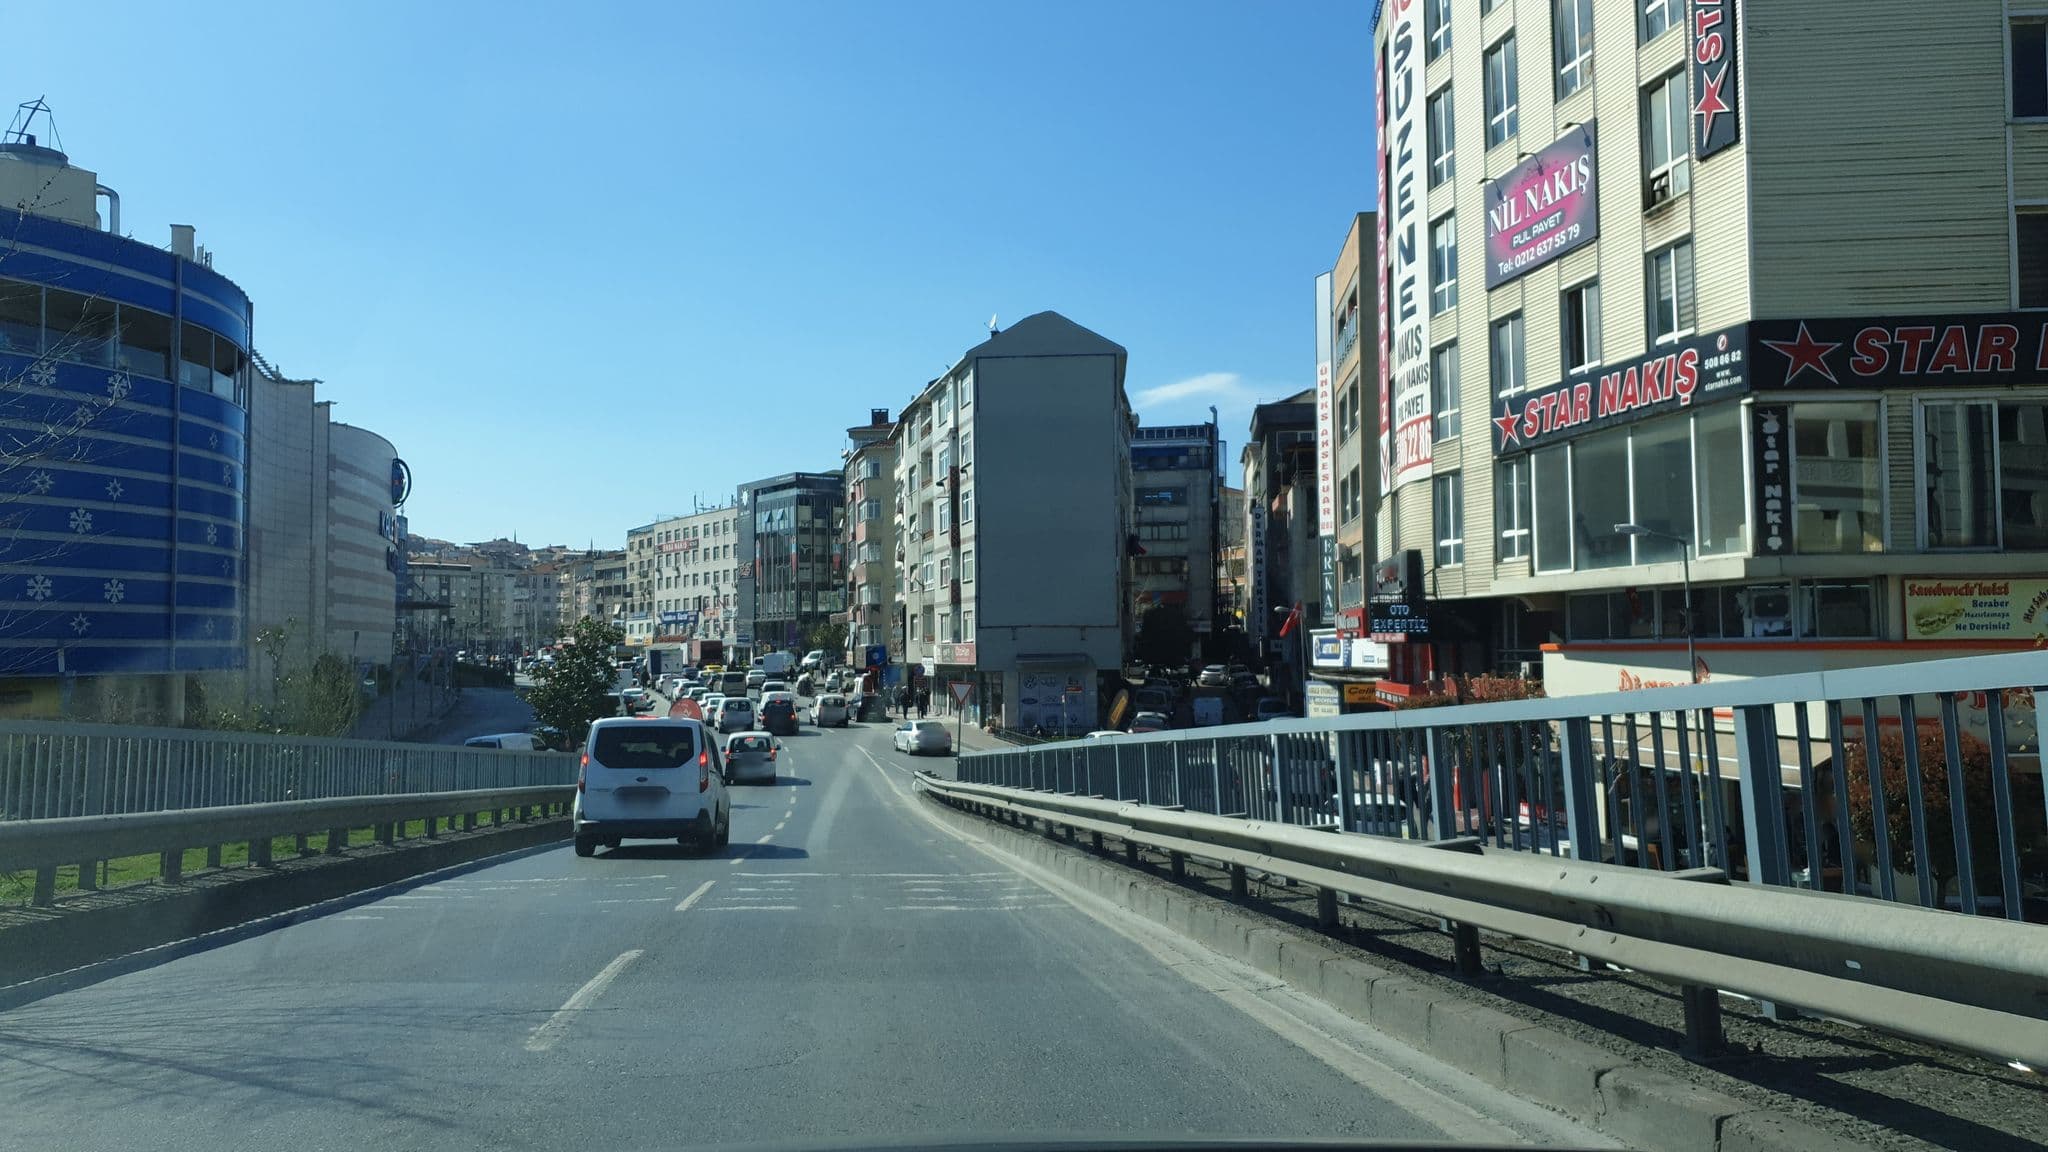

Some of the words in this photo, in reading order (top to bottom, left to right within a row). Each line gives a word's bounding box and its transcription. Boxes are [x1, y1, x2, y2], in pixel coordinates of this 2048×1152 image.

[1393, 20, 1417, 324] SÜZENE
[1489, 195, 1522, 238] NİL
[1524, 154, 1590, 218] NAKIŞ
[1498, 260, 1513, 276] Tel:
[1515, 246, 1535, 268] 0212
[1537, 239, 1553, 256] 637
[1554, 232, 1567, 249] 55
[1568, 223, 1580, 240] 79
[1512, 230, 1531, 248] PUL
[1532, 211, 1562, 237] PAYET
[1849, 324, 2019, 376] STAR
[1523, 382, 1592, 439] STAR
[1597, 347, 1699, 418] NAKIŞ
[1373, 615, 1427, 629] EXPERTİZ
[1389, 604, 1410, 615] OTO
[1972, 599, 2010, 608] Beraber
[1955, 623, 1967, 631] Ne
[1969, 621, 2011, 632] Dersiniz?
